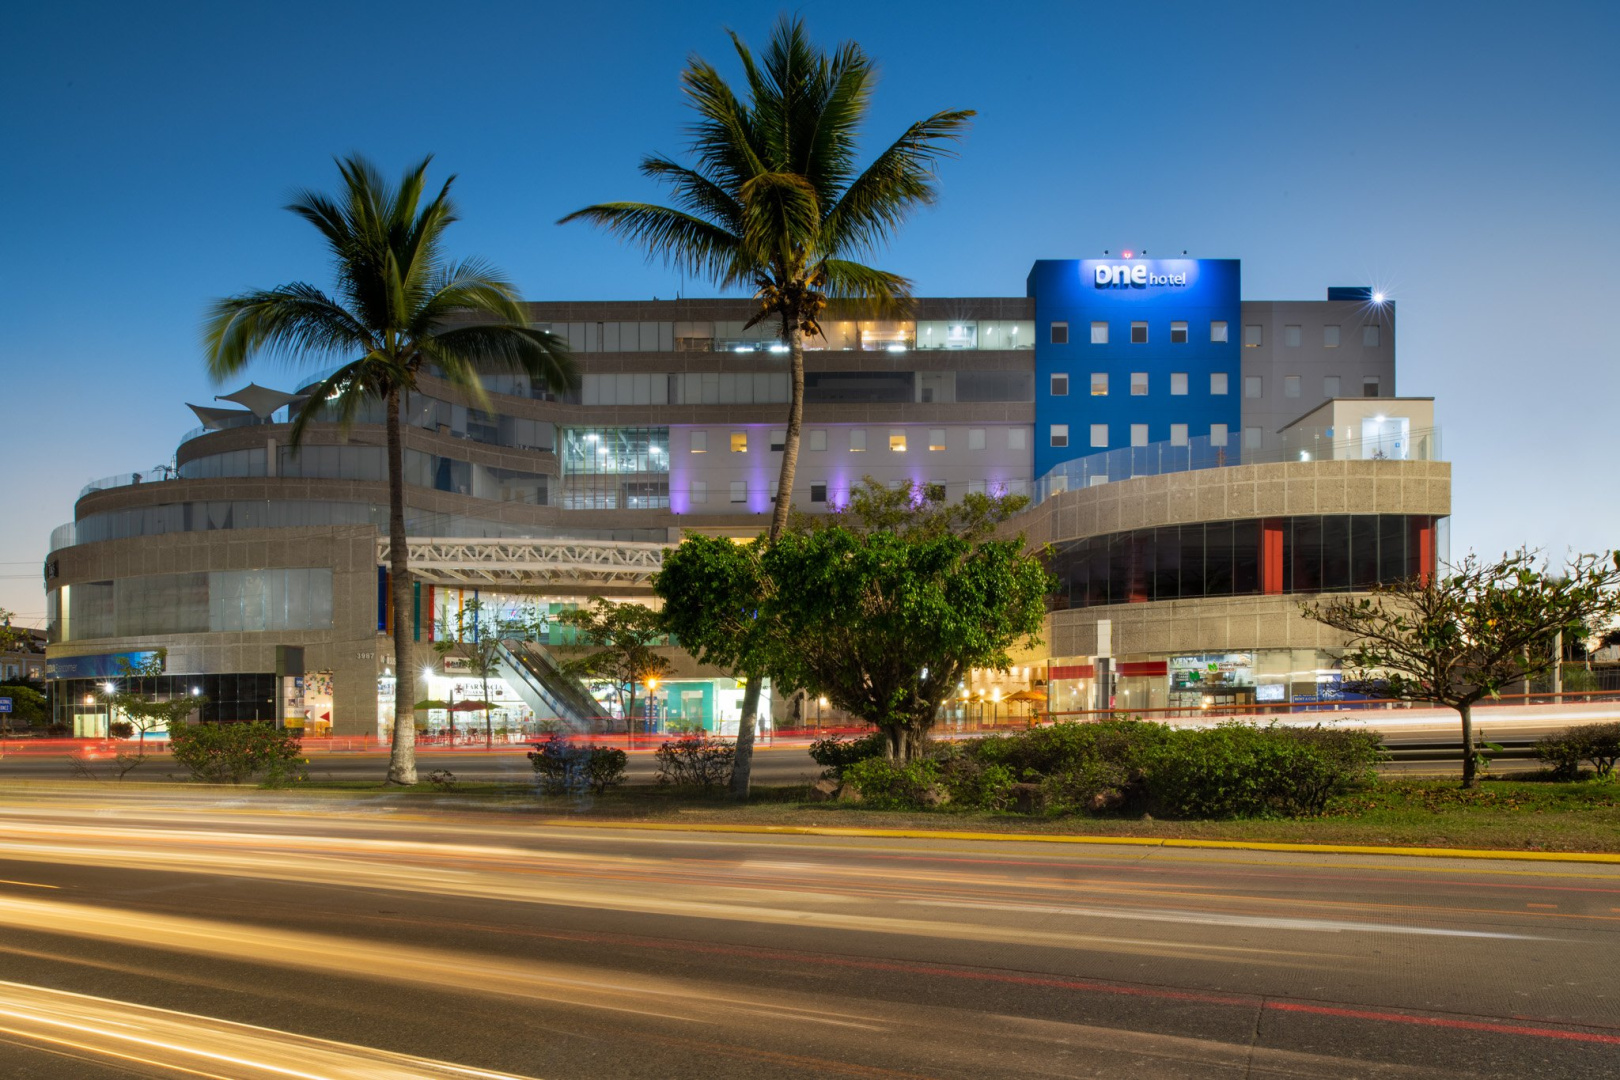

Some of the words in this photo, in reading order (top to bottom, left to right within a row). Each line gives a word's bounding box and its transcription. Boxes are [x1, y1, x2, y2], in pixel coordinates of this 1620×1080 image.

[1095, 264, 1147, 287] one
[1149, 272, 1186, 286] hotel
[356, 652, 375, 660] 3987
